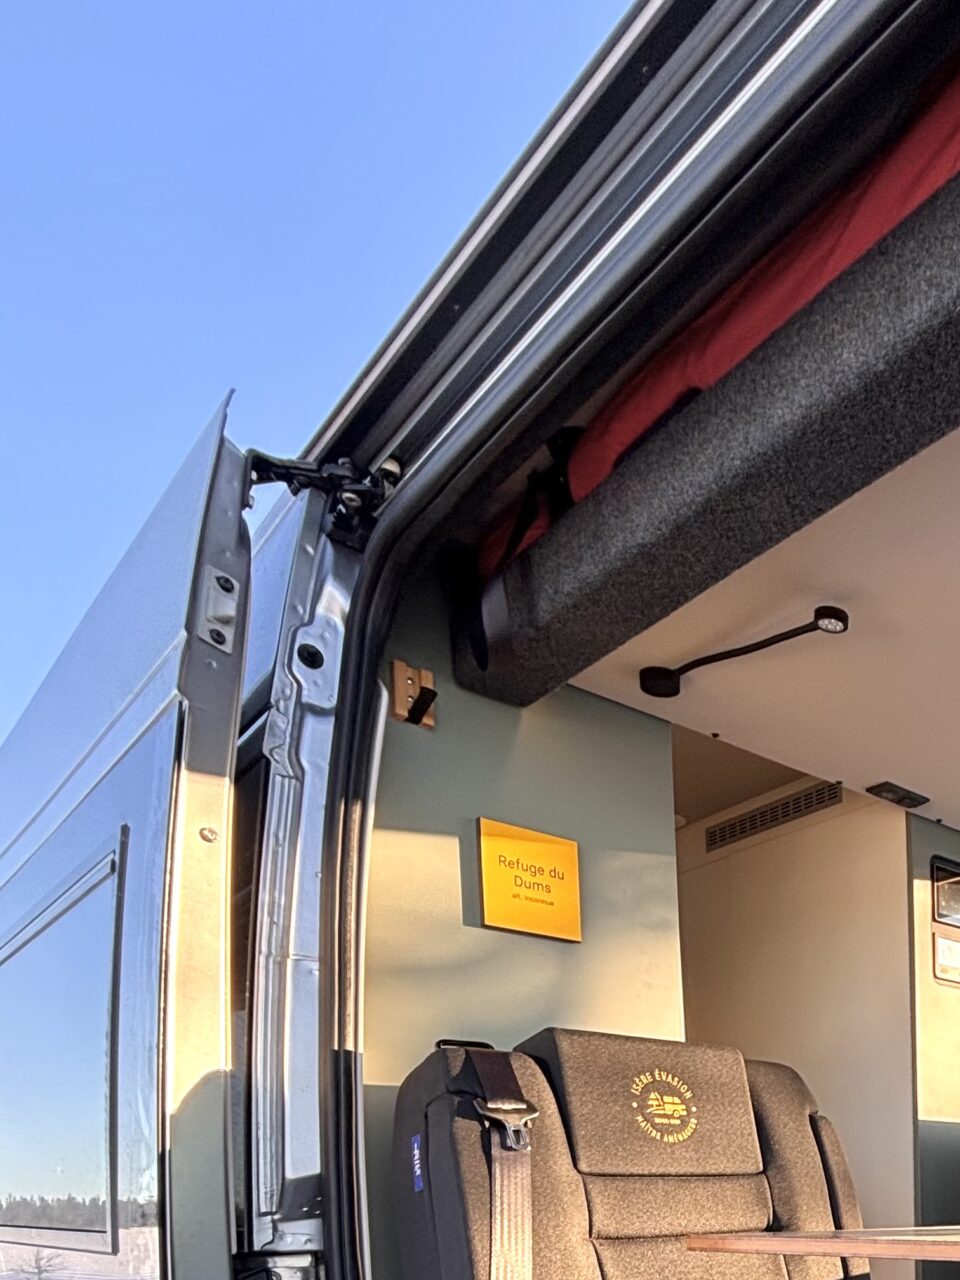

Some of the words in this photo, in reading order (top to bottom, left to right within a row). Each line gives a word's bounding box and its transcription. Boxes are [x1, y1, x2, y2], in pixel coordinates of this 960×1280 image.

[498, 854, 544, 877] Refuge
[549, 866, 565, 880] du
[514, 875, 552, 893] Dums
[630, 1071, 654, 1096] ISÈRE
[654, 1067, 694, 1099] ÉVASION
[635, 1114, 661, 1141] MAÎTRE
[663, 1117, 698, 1143] AMÉNAGEUR
